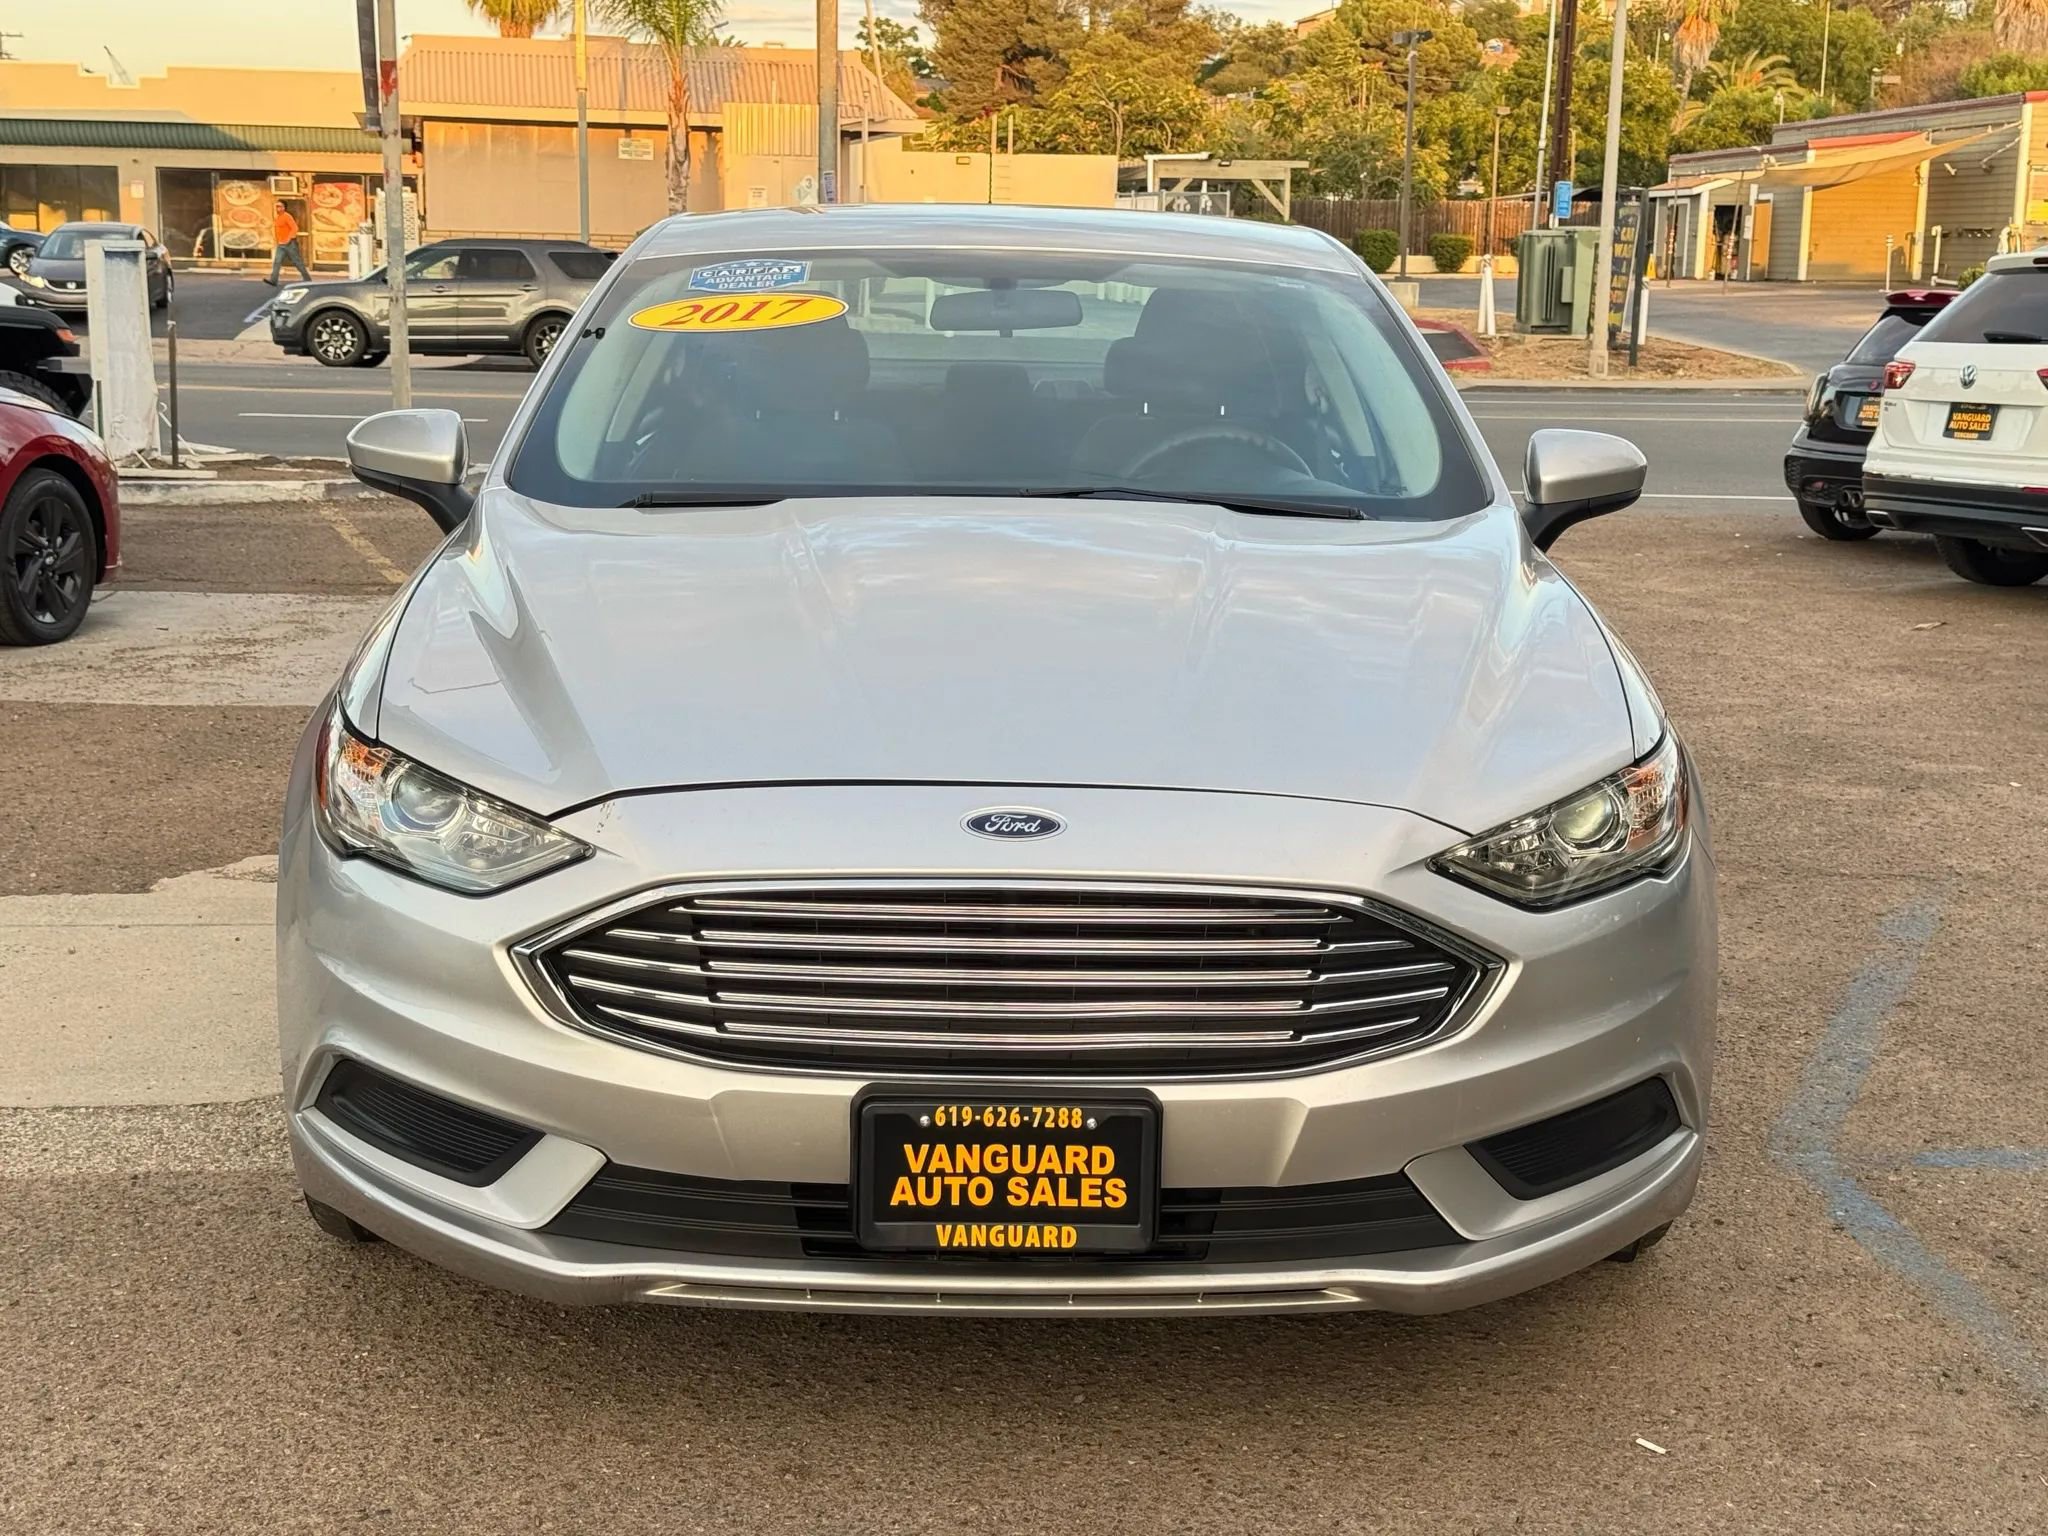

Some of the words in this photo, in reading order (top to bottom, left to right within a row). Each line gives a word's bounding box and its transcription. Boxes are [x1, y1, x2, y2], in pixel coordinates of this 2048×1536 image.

[701, 265, 802, 278] CARFAX
[704, 273, 792, 285] ADVANTAGE
[718, 280, 776, 290] DEALER
[659, 298, 814, 327] 2017
[1948, 421, 1968, 430] AUTO
[1968, 421, 1990, 431] SALES
[1952, 412, 1992, 423] VANGUARD
[984, 814, 1042, 833] Ford
[934, 1105, 1083, 1129] 619-626-7288
[903, 1143, 1116, 1176] VANGUARD
[889, 1176, 995, 1207] AUTO
[1006, 1177, 1128, 1209] SALES
[936, 1224, 1078, 1249] VANGUARD
